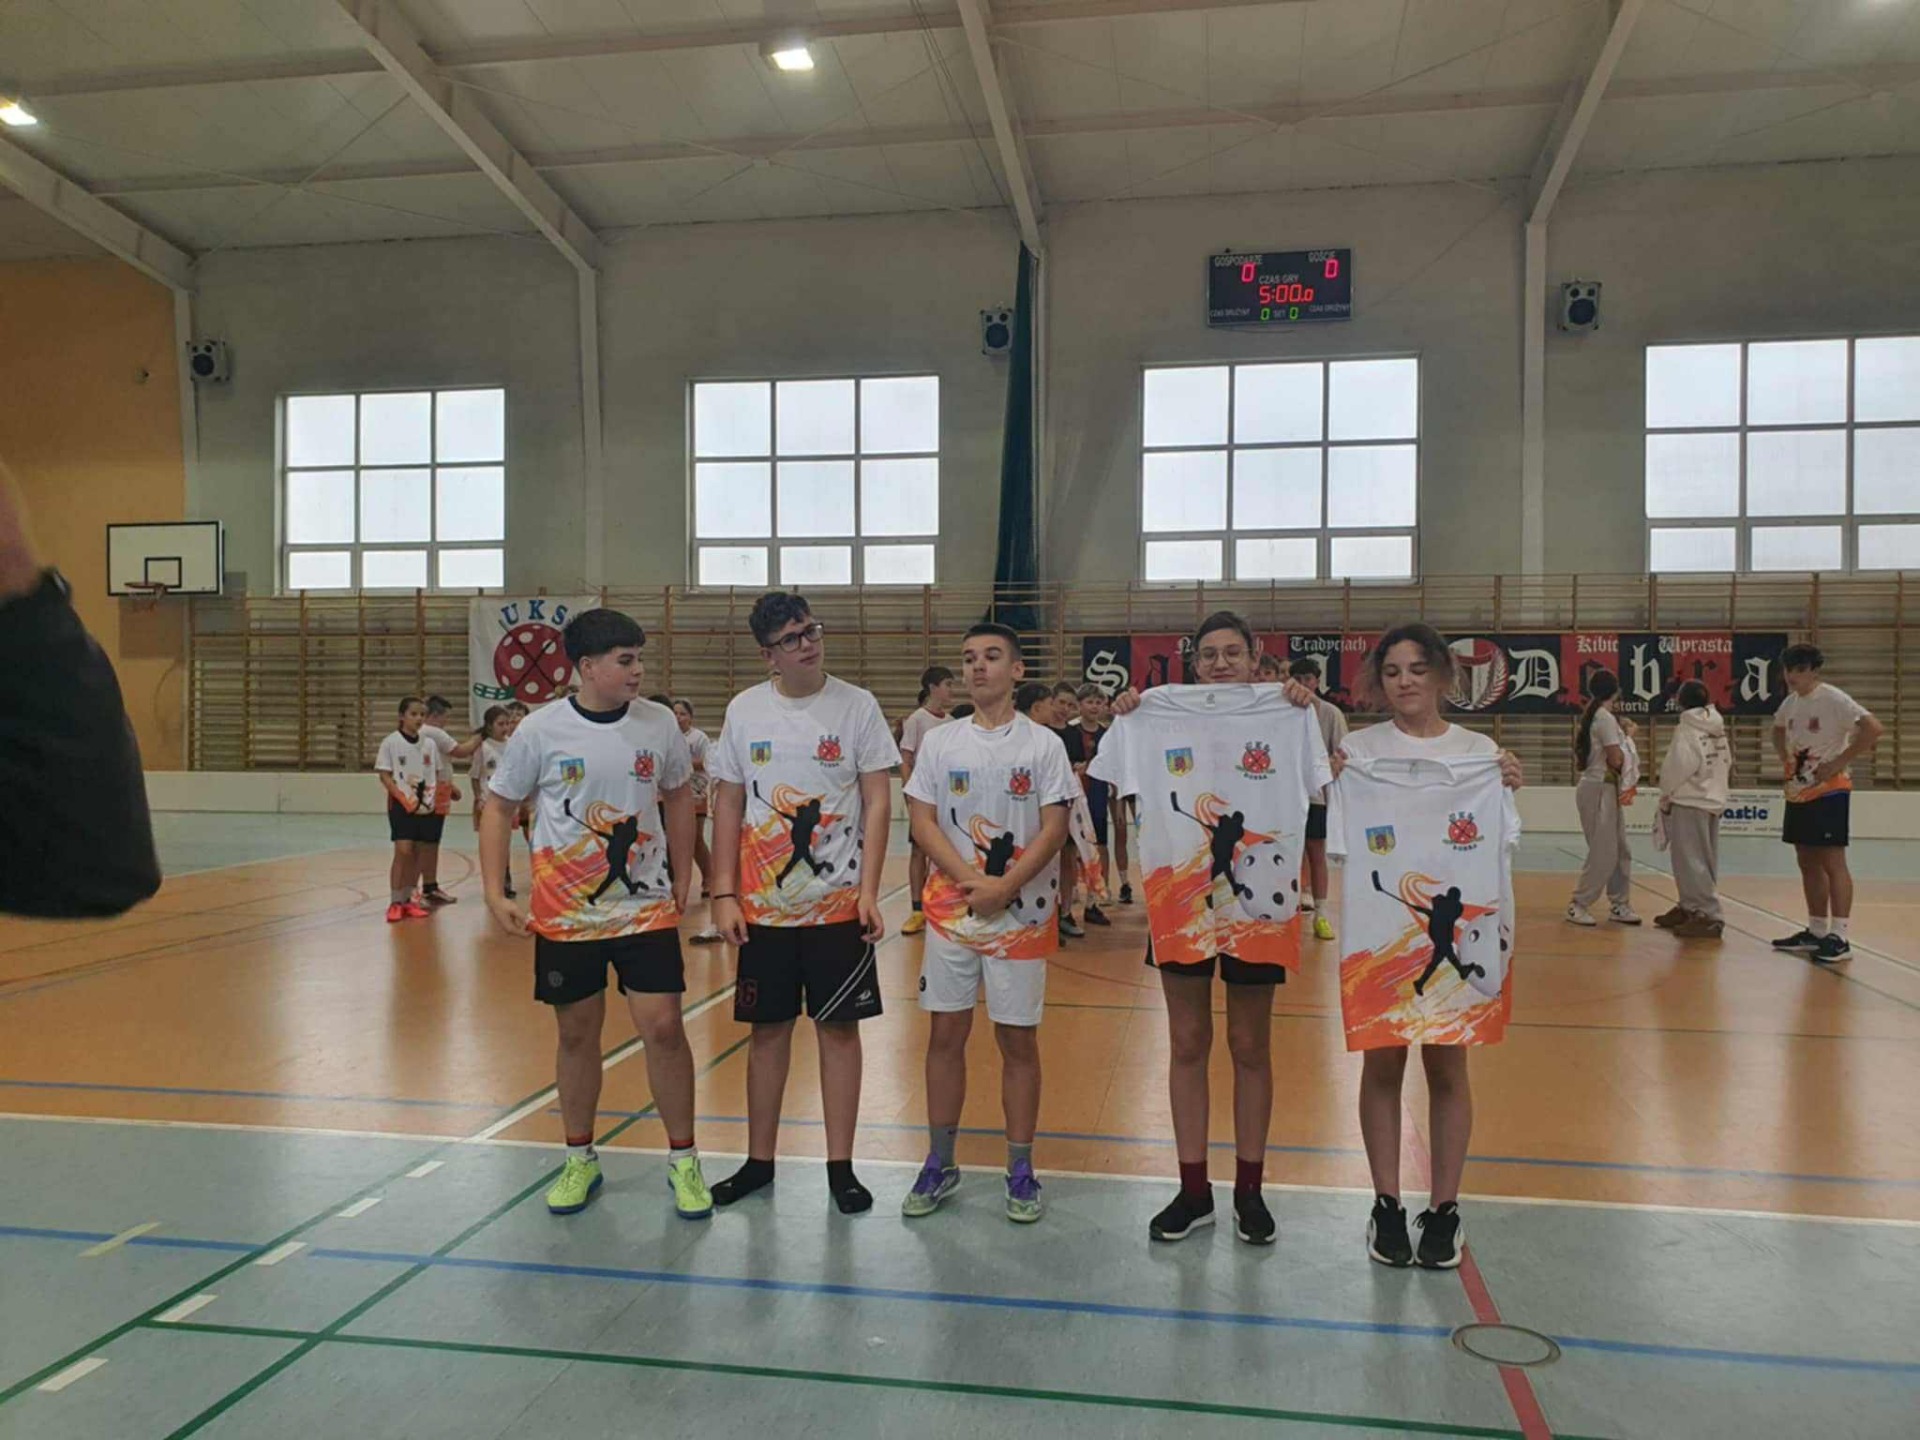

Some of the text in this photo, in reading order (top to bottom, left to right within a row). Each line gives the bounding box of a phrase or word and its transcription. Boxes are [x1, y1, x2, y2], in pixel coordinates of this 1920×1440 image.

[1241, 262, 1256, 283] 0
[1324, 258, 1339, 279] 0
[1260, 307, 1271, 320] 0
[1289, 306, 1299, 319] 0
[501, 600, 568, 625] UKS
[1577, 636, 1619, 653] Kibic
